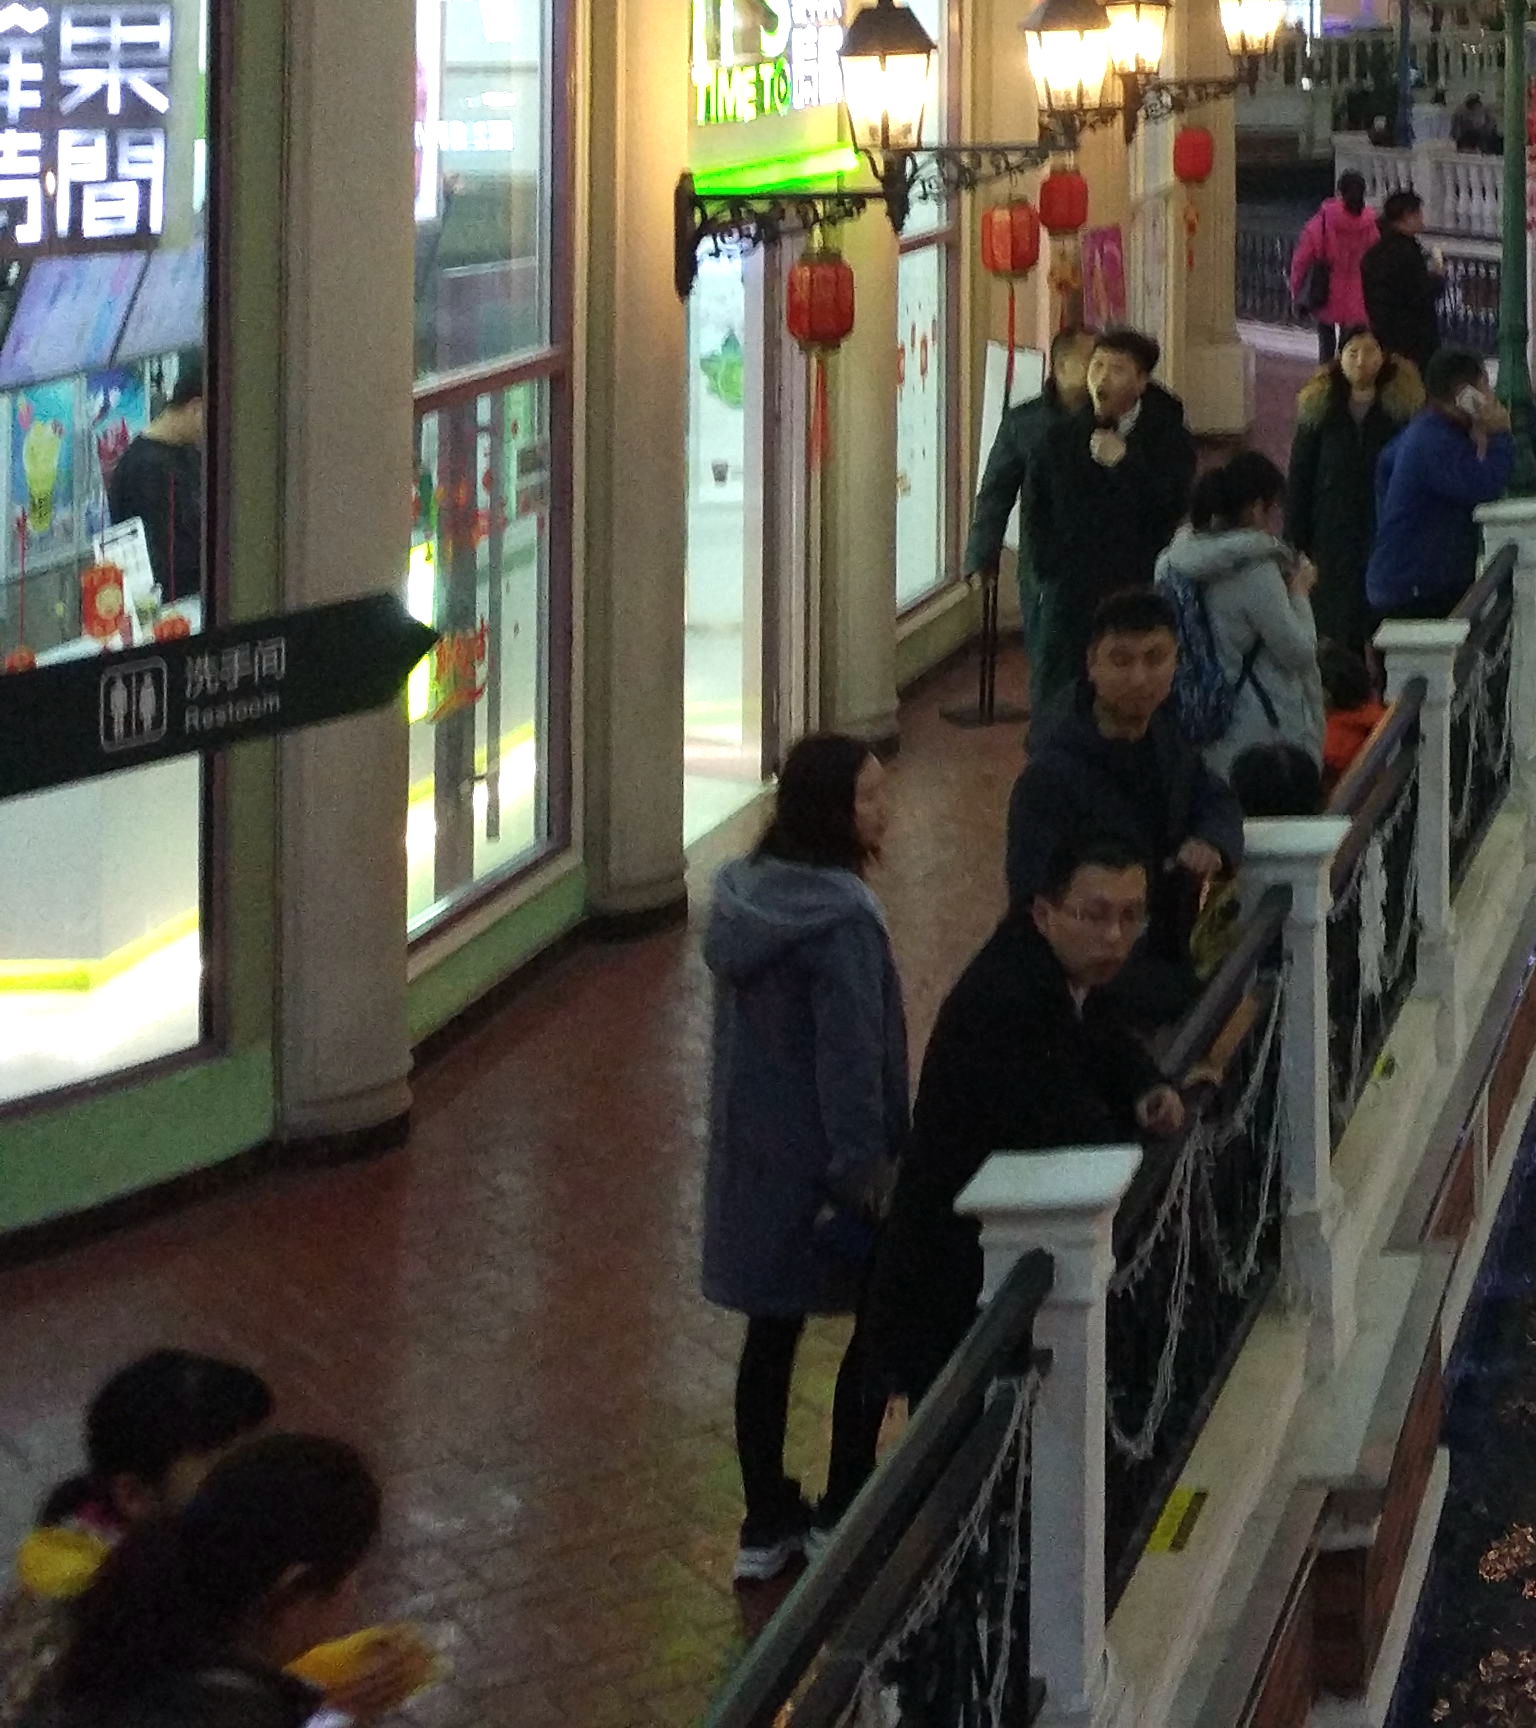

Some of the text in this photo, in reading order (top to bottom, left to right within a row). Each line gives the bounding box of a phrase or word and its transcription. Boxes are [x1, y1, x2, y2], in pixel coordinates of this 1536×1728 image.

[694, 57, 792, 125] TIME TO
[185, 636, 286, 698] 洗手间
